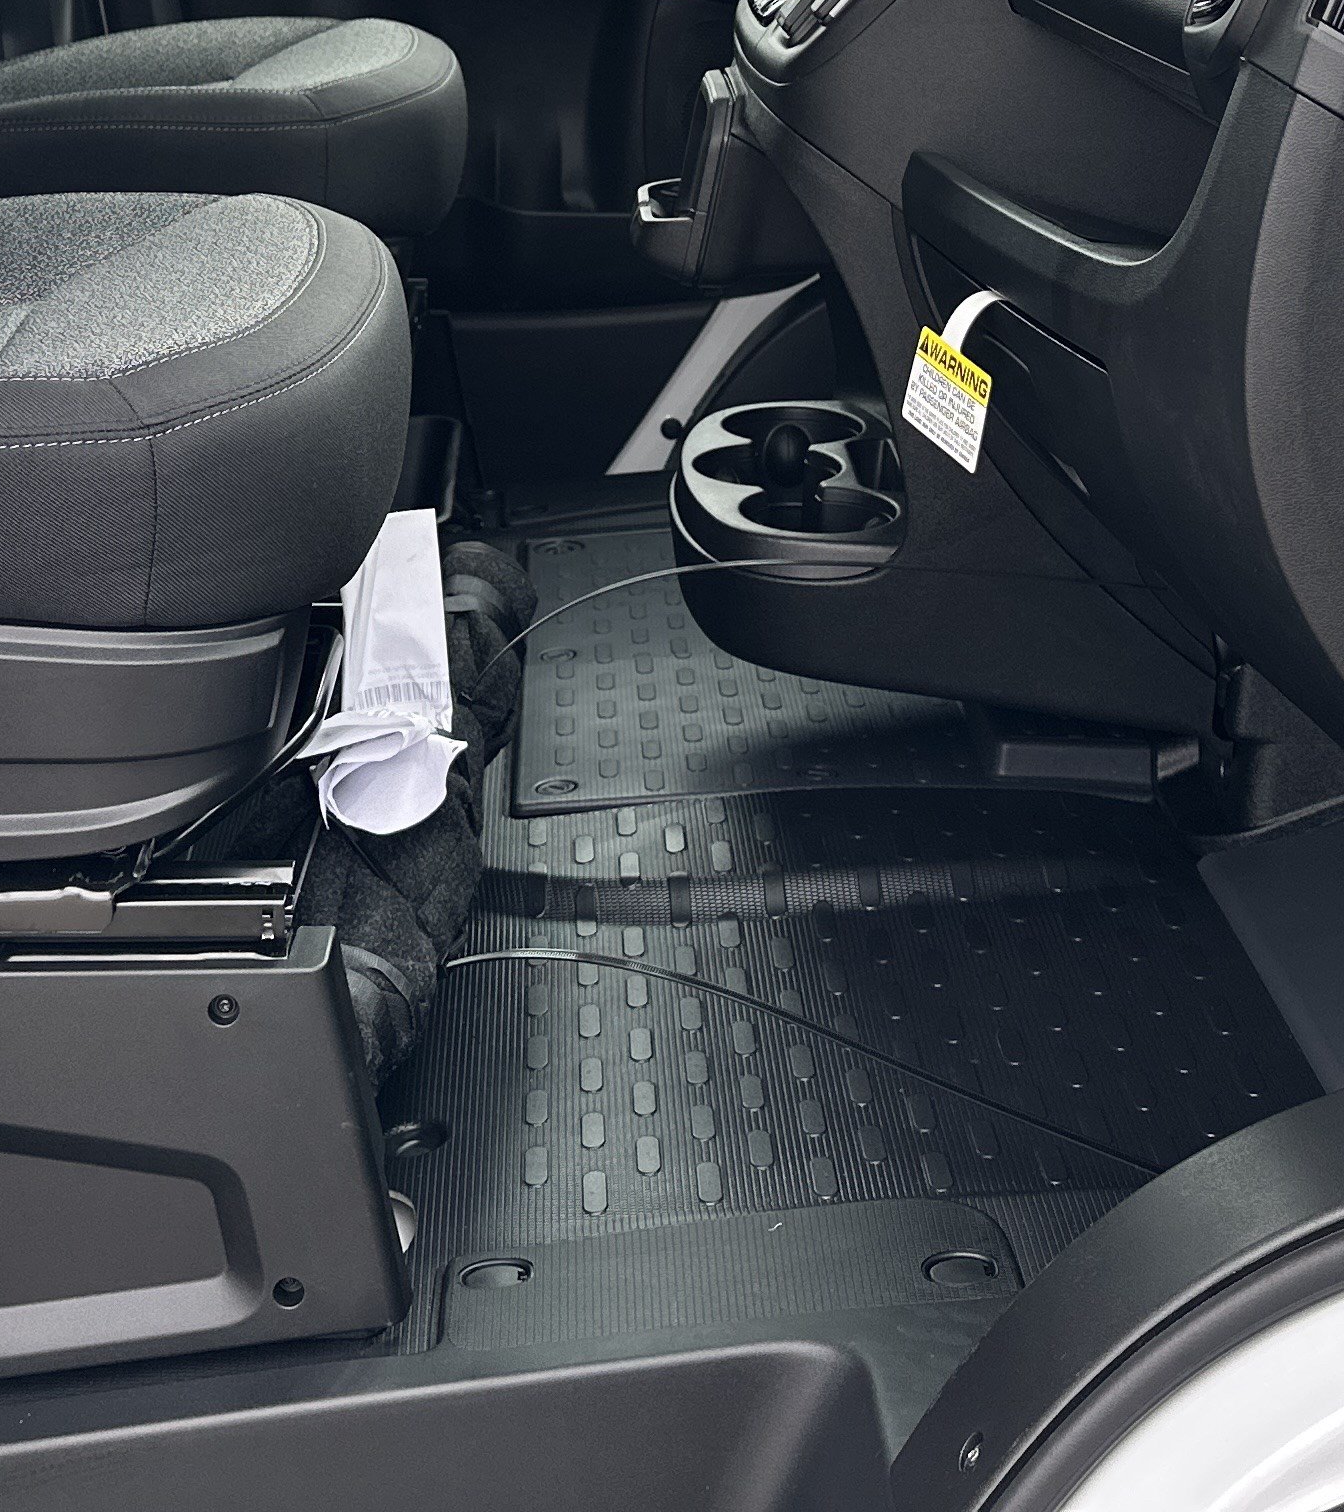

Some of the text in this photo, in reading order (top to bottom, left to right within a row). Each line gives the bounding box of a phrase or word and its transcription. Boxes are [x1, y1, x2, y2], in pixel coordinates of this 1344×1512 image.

[921, 362, 951, 393] CHILDREN
[951, 385, 965, 404] CAN
[929, 340, 988, 399] WARNING
[917, 372, 975, 425] KILLED OR INJURED
[918, 386, 954, 422] PASSENGER
[954, 415, 978, 442] AIRBAG
